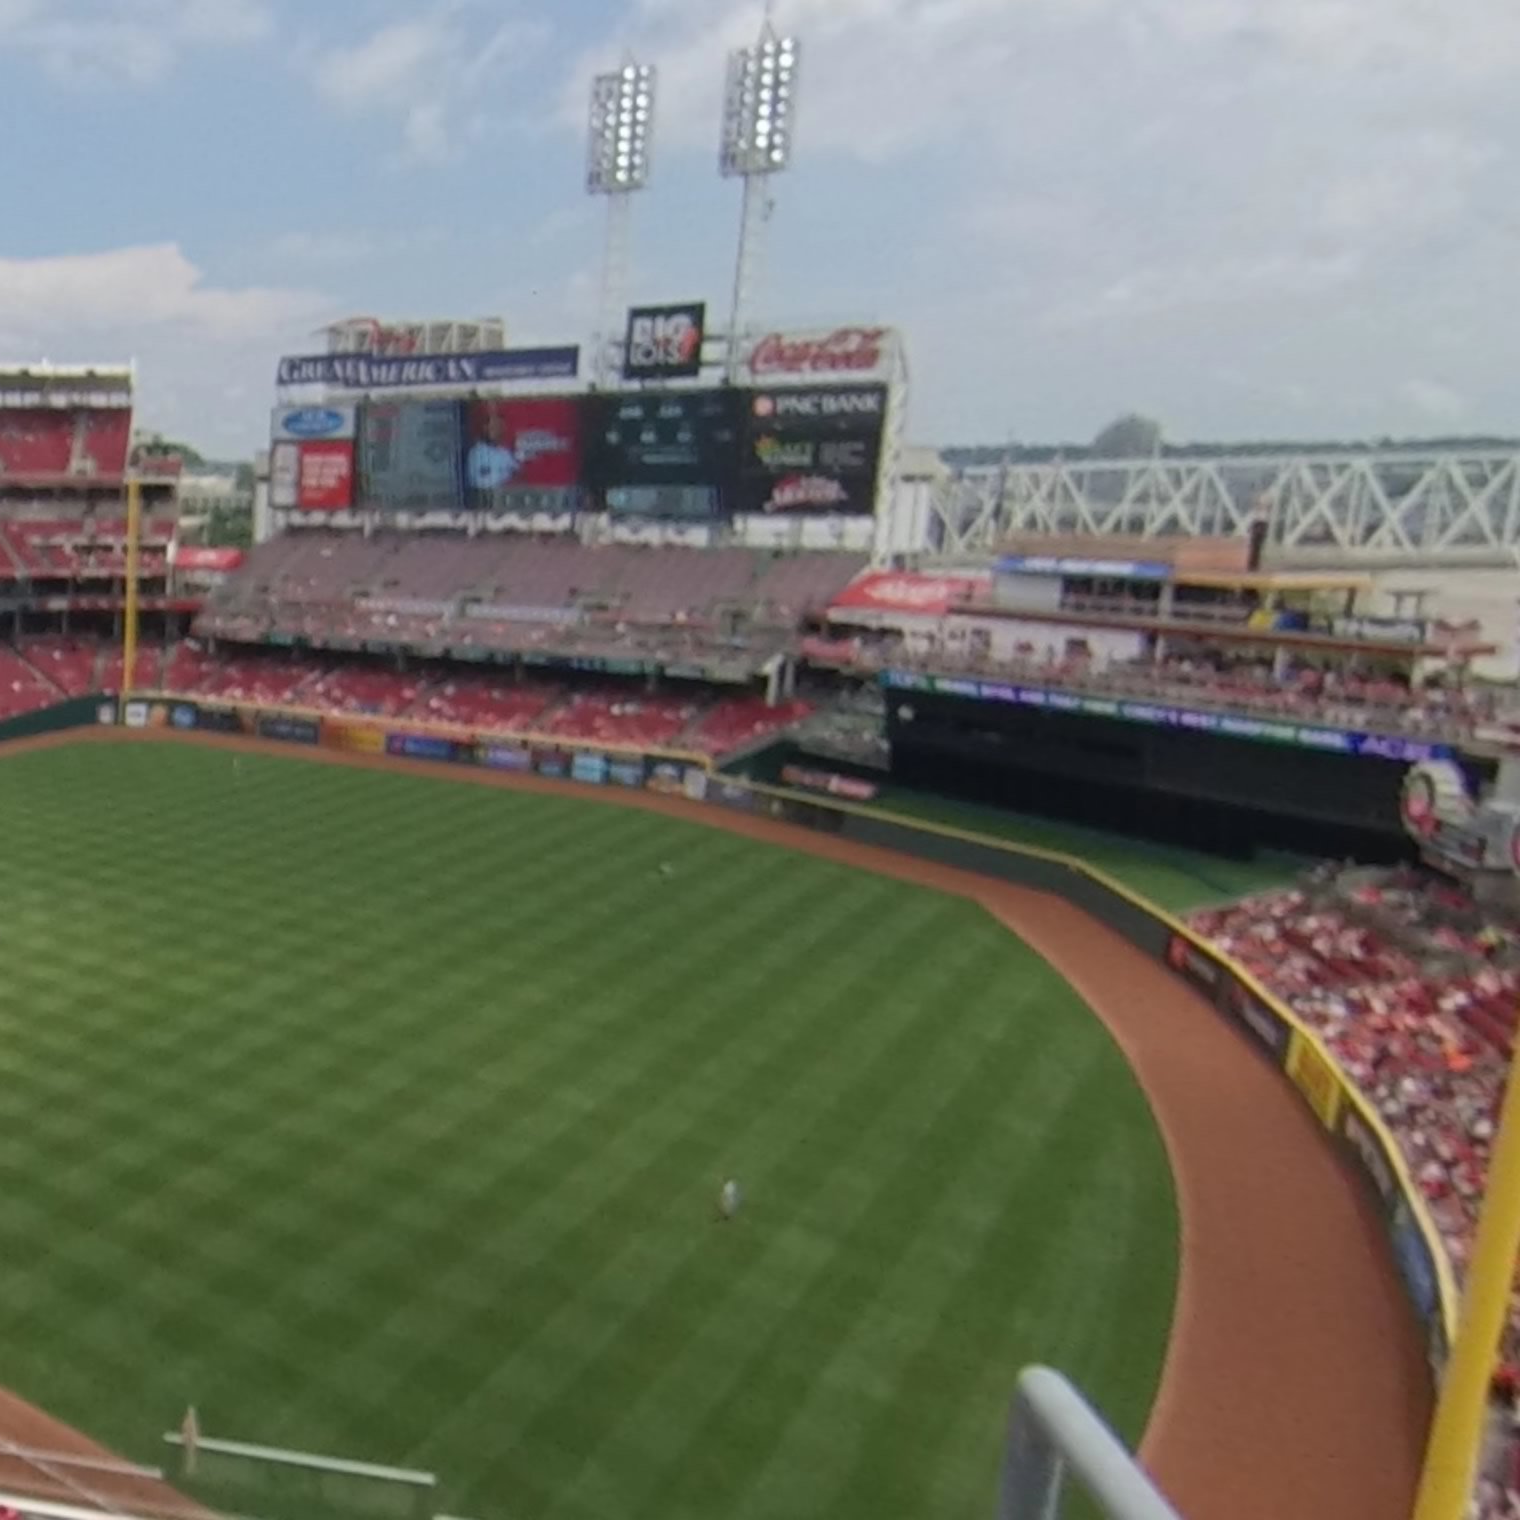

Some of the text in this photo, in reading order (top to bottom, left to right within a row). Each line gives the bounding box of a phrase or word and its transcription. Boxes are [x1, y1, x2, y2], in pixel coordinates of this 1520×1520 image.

[632, 313, 694, 344] BIG
[280, 358, 366, 383] GREAT
[356, 355, 478, 384] AMERICAN
[776, 392, 879, 414] PNC BANK
